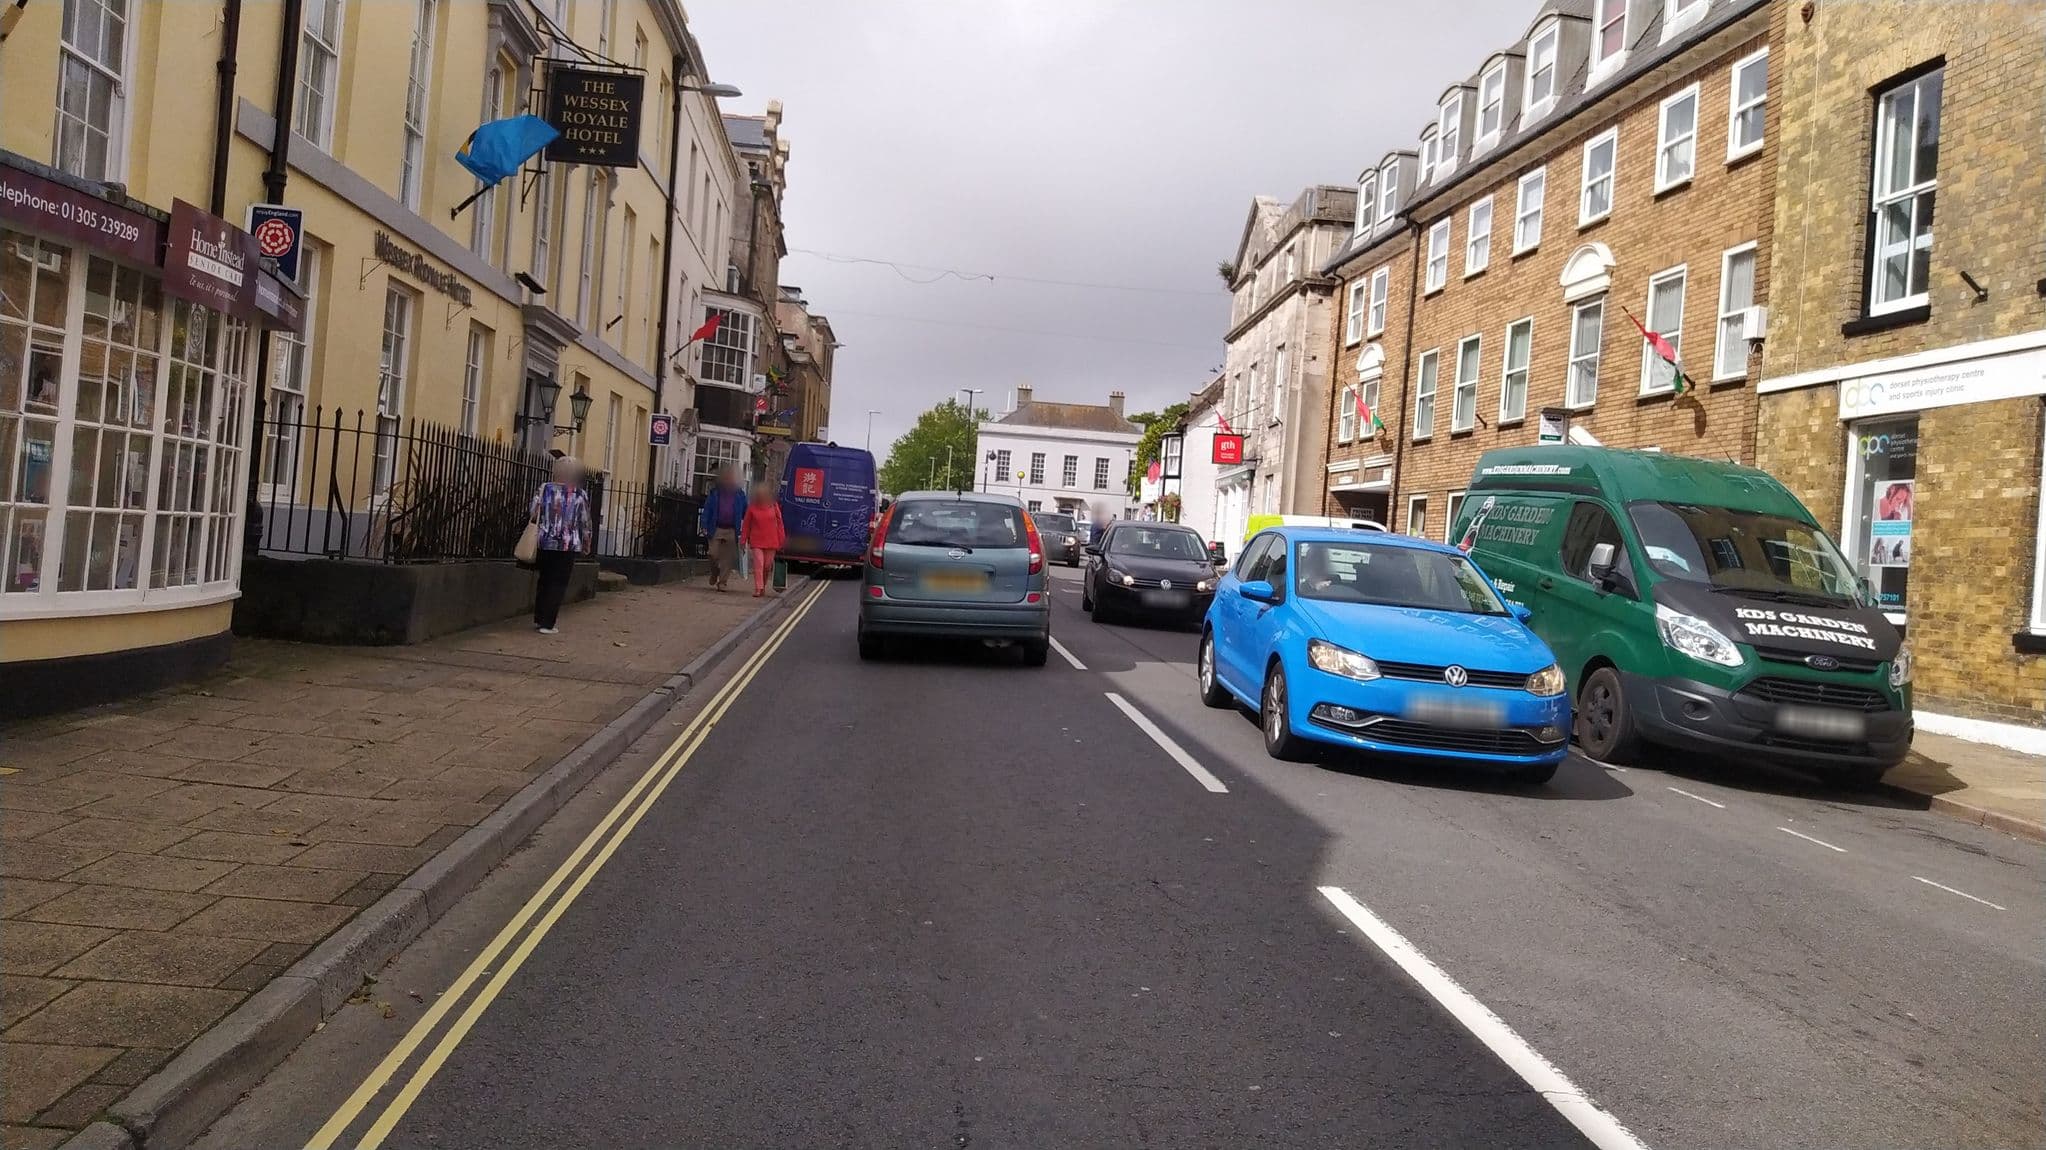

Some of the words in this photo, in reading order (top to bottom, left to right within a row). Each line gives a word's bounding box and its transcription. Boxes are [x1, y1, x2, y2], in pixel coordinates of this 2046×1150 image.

[582, 80, 615, 95] THE
[564, 95, 630, 113] WESSEX
[562, 111, 629, 129] ROYALE
[566, 128, 622, 145] HOTEL
[61, 202, 97, 229] 01305
[100, 215, 139, 243] 239289
[191, 228, 218, 258] Home
[1488, 504, 1507, 521] KDS
[1507, 506, 1555, 525] GARDEN
[1479, 524, 1540, 546] MACHINERY
[1735, 608, 1779, 621] KDS
[1779, 612, 1868, 634] GARDEN
[1744, 623, 1876, 650] MACHINERY
